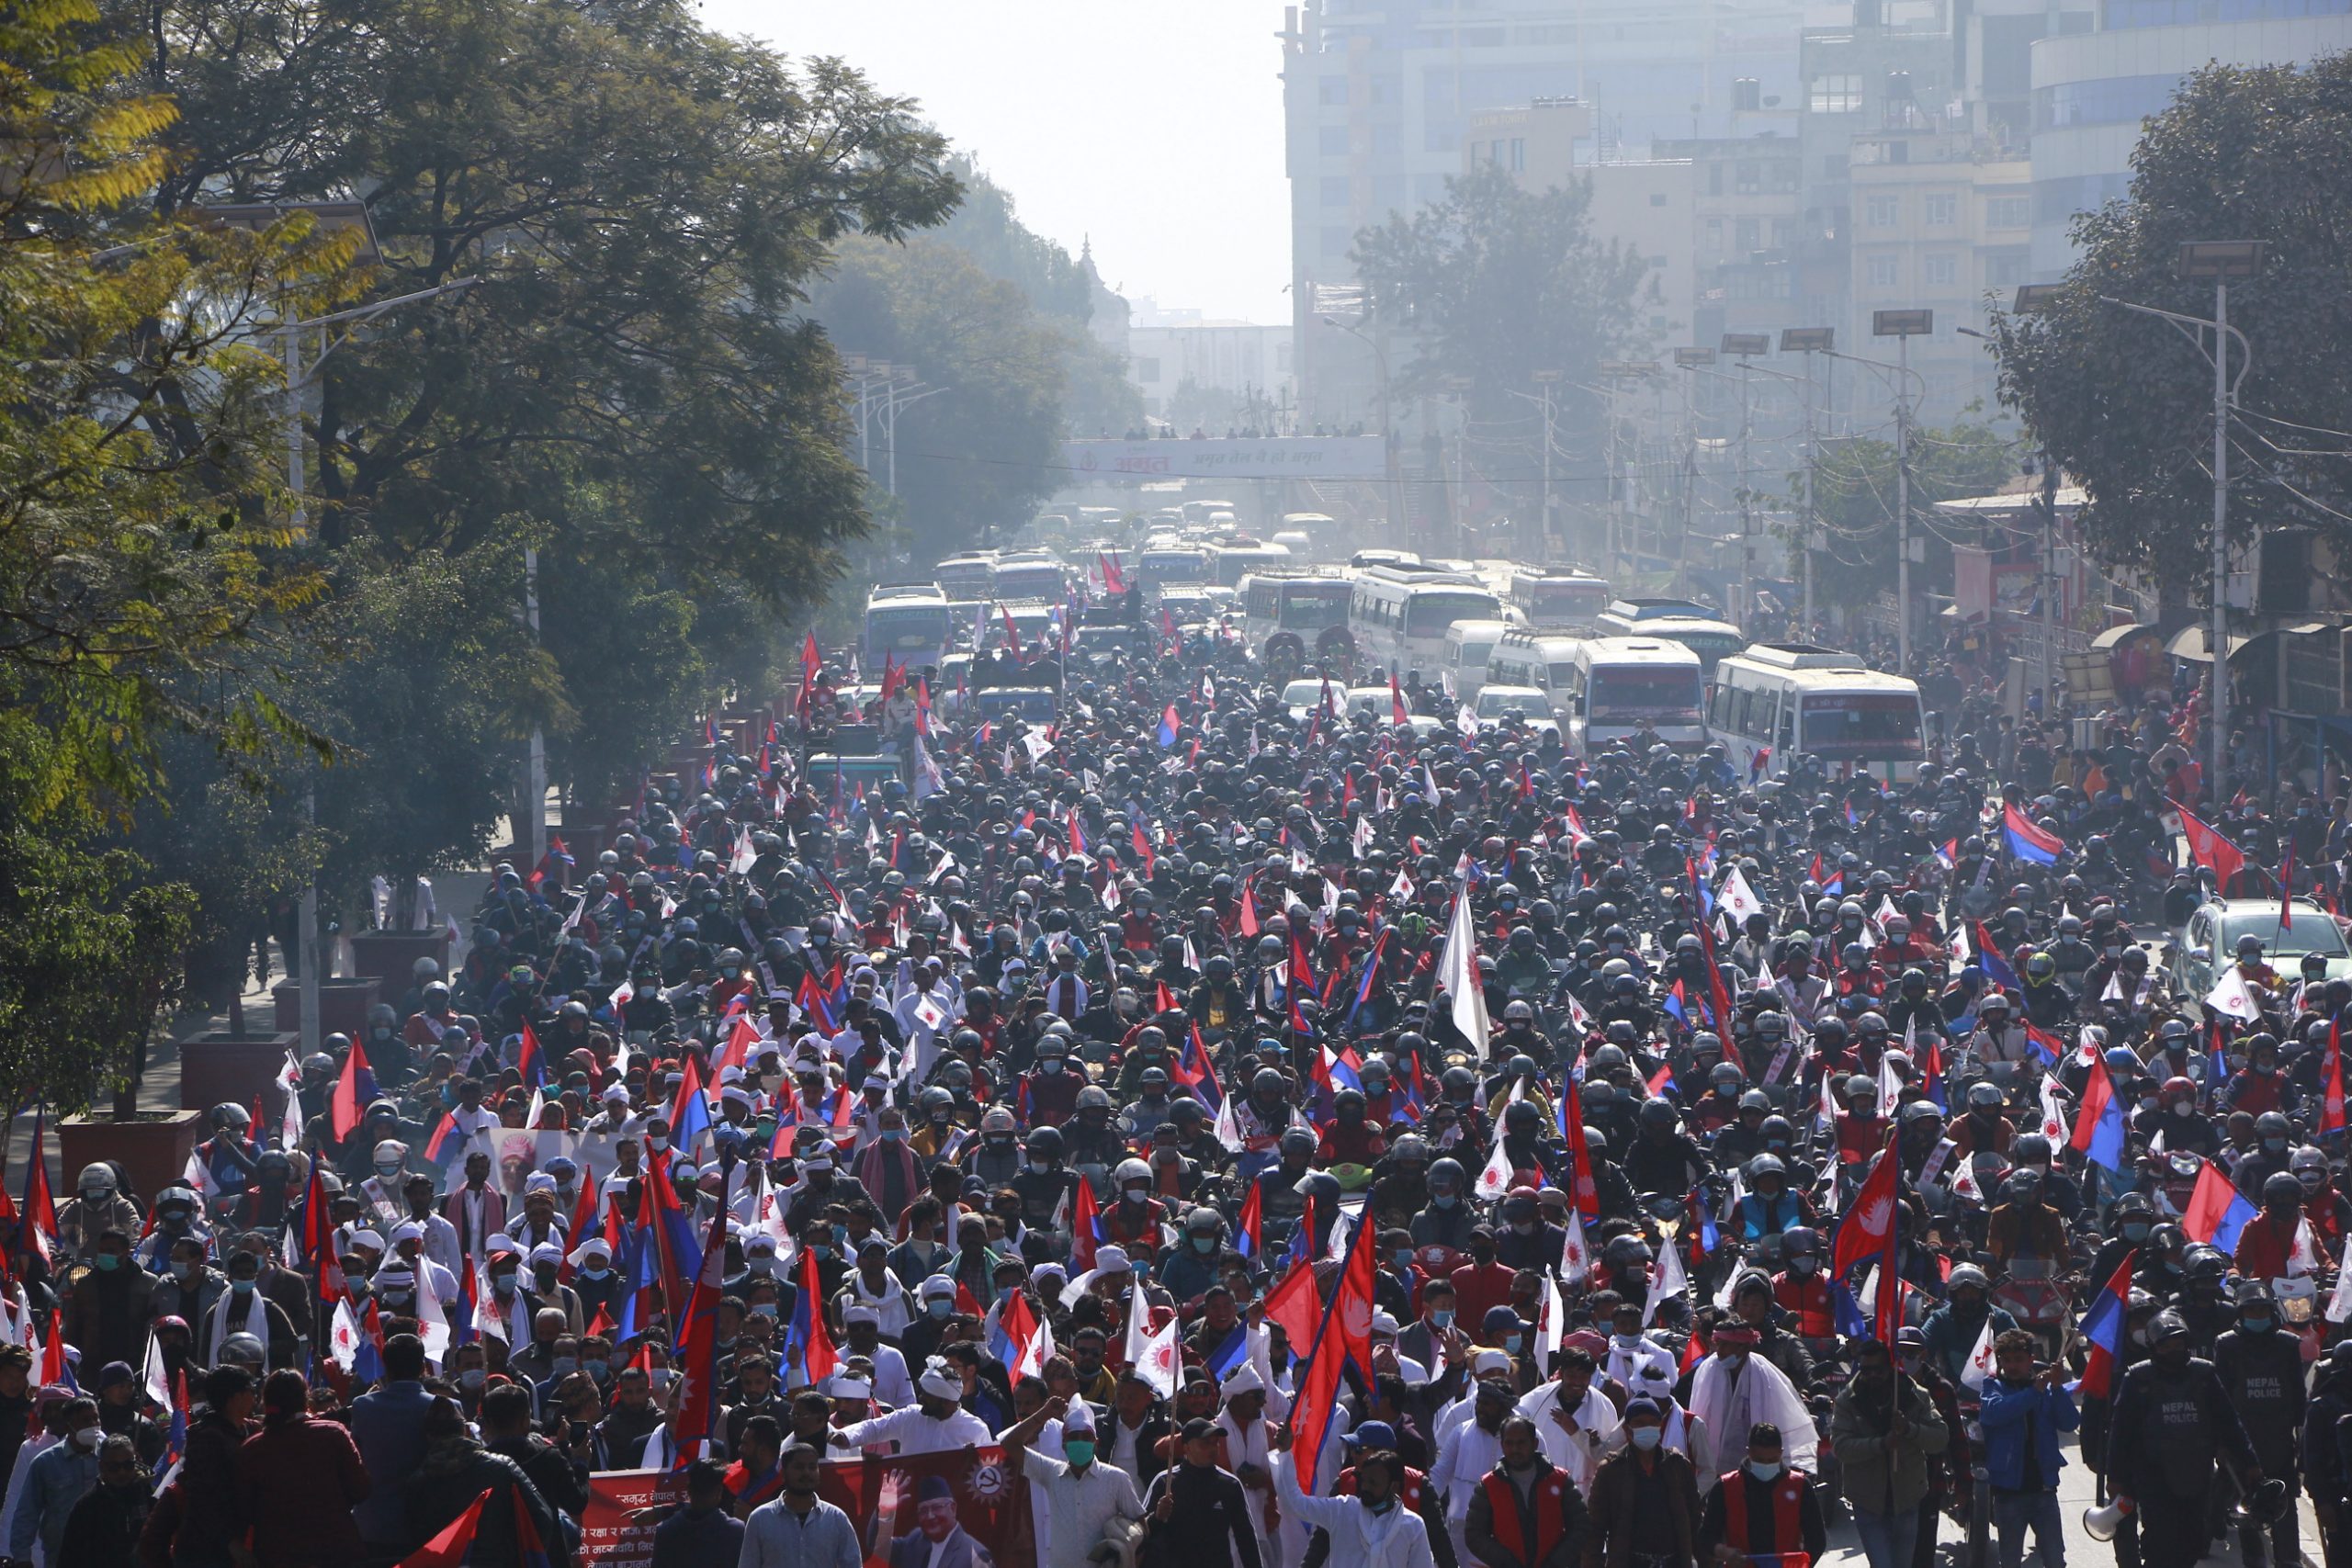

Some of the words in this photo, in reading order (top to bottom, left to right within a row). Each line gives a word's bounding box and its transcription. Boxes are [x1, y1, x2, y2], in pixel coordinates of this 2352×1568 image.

[2246, 1377, 2280, 1388] NEPAL
[2246, 1388, 2282, 1399] POLICE
[2162, 1401, 2198, 1413] NEPAL
[2163, 1413, 2199, 1425] POLICE
[589, 1527, 607, 1538] रक्षा
